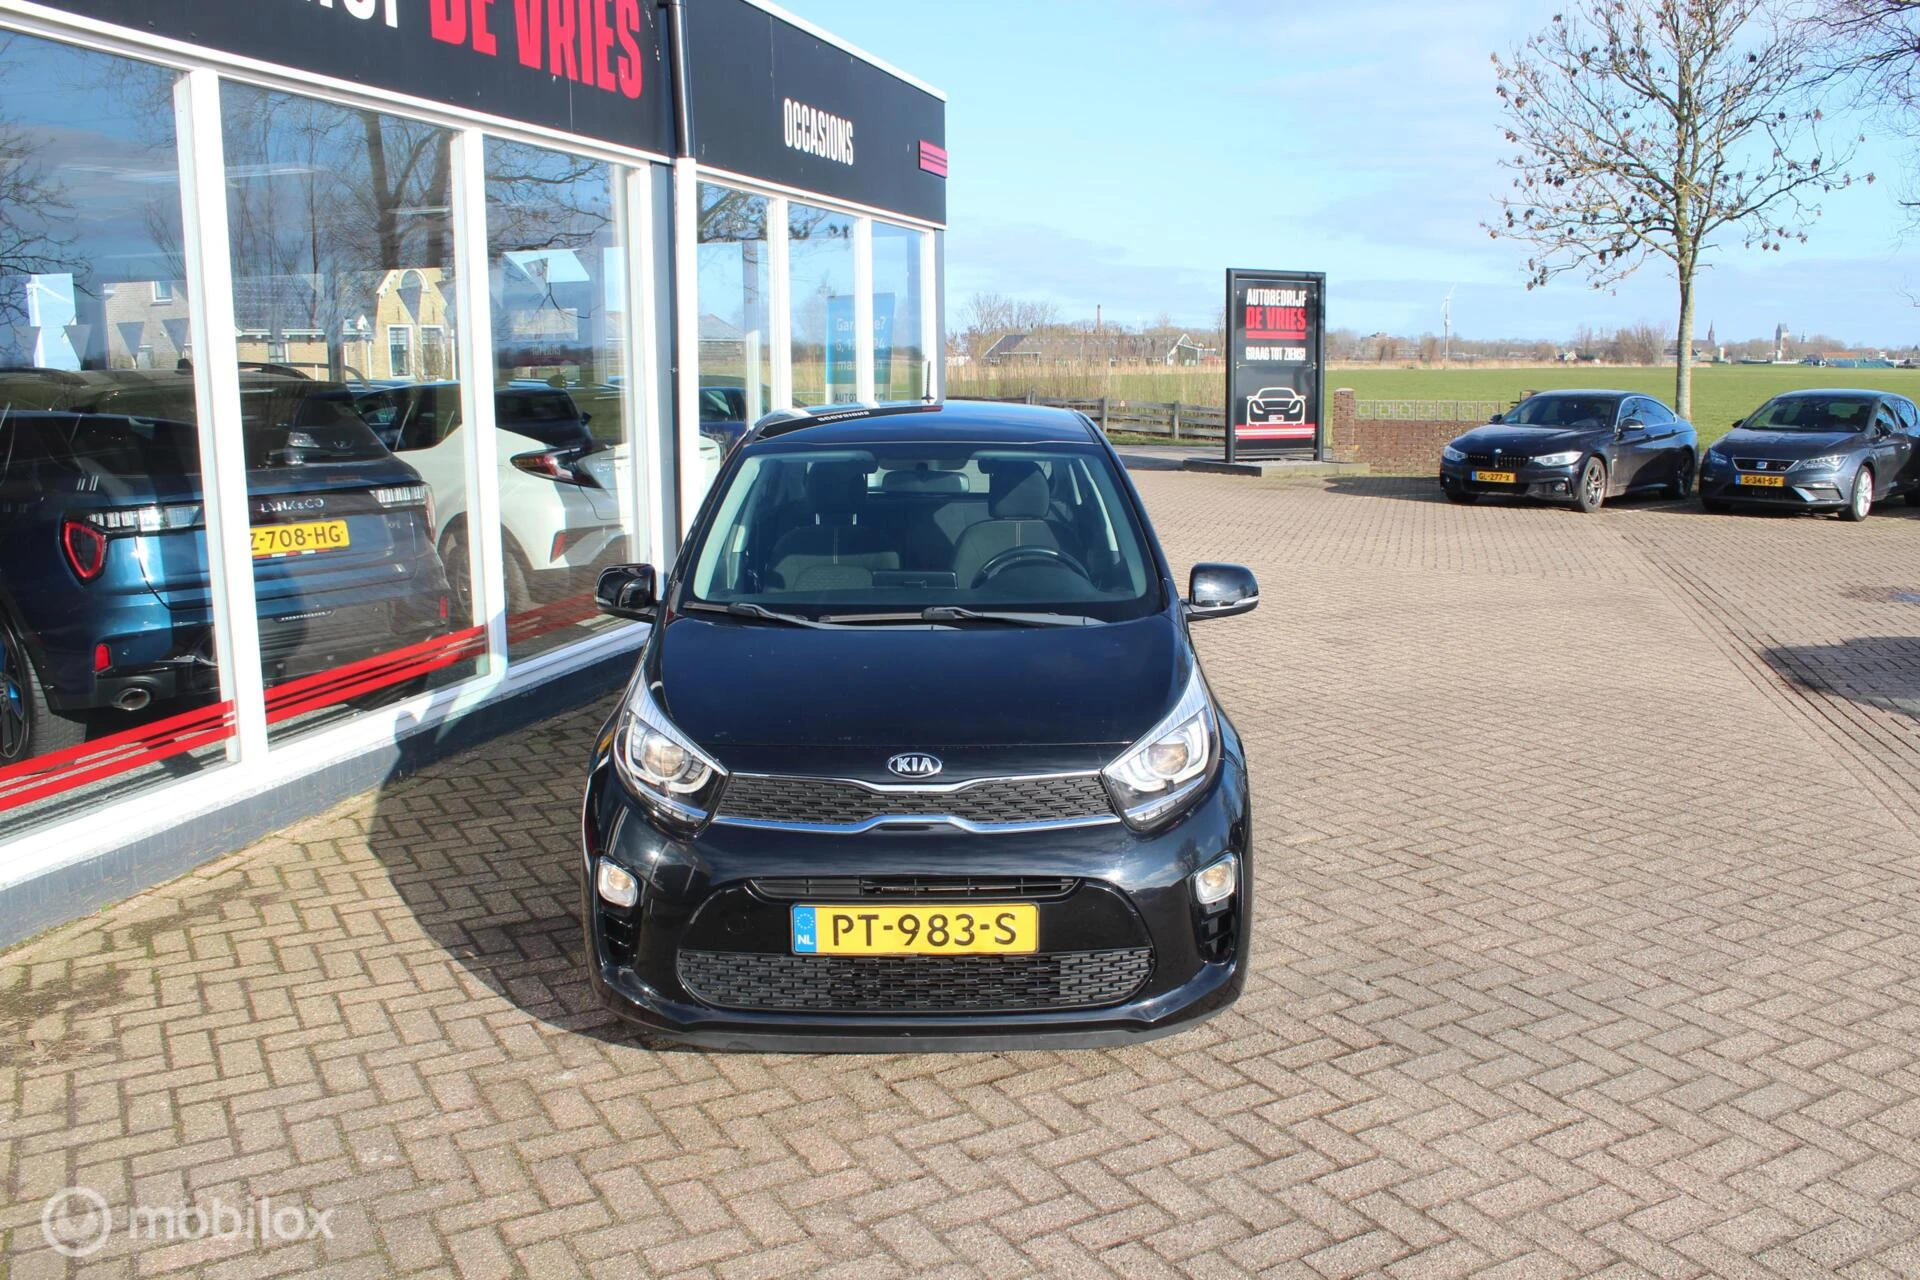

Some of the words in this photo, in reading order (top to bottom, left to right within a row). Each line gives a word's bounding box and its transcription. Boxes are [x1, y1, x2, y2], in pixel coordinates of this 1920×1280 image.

[513, 0, 642, 99] VRIES
[784, 98, 854, 166] OCCASIONS
[1246, 288, 1308, 307] AUTOBEDRIJF
[1246, 306, 1263, 330] DE
[1265, 307, 1306, 330] VRIES
[1245, 346, 1270, 361] GRAAG
[1270, 347, 1283, 361] TOT
[1283, 347, 1306, 361] ZIENS!
[897, 757, 934, 772] KIA
[797, 935, 814, 945] NL
[832, 913, 1017, 947] PT-983-S
